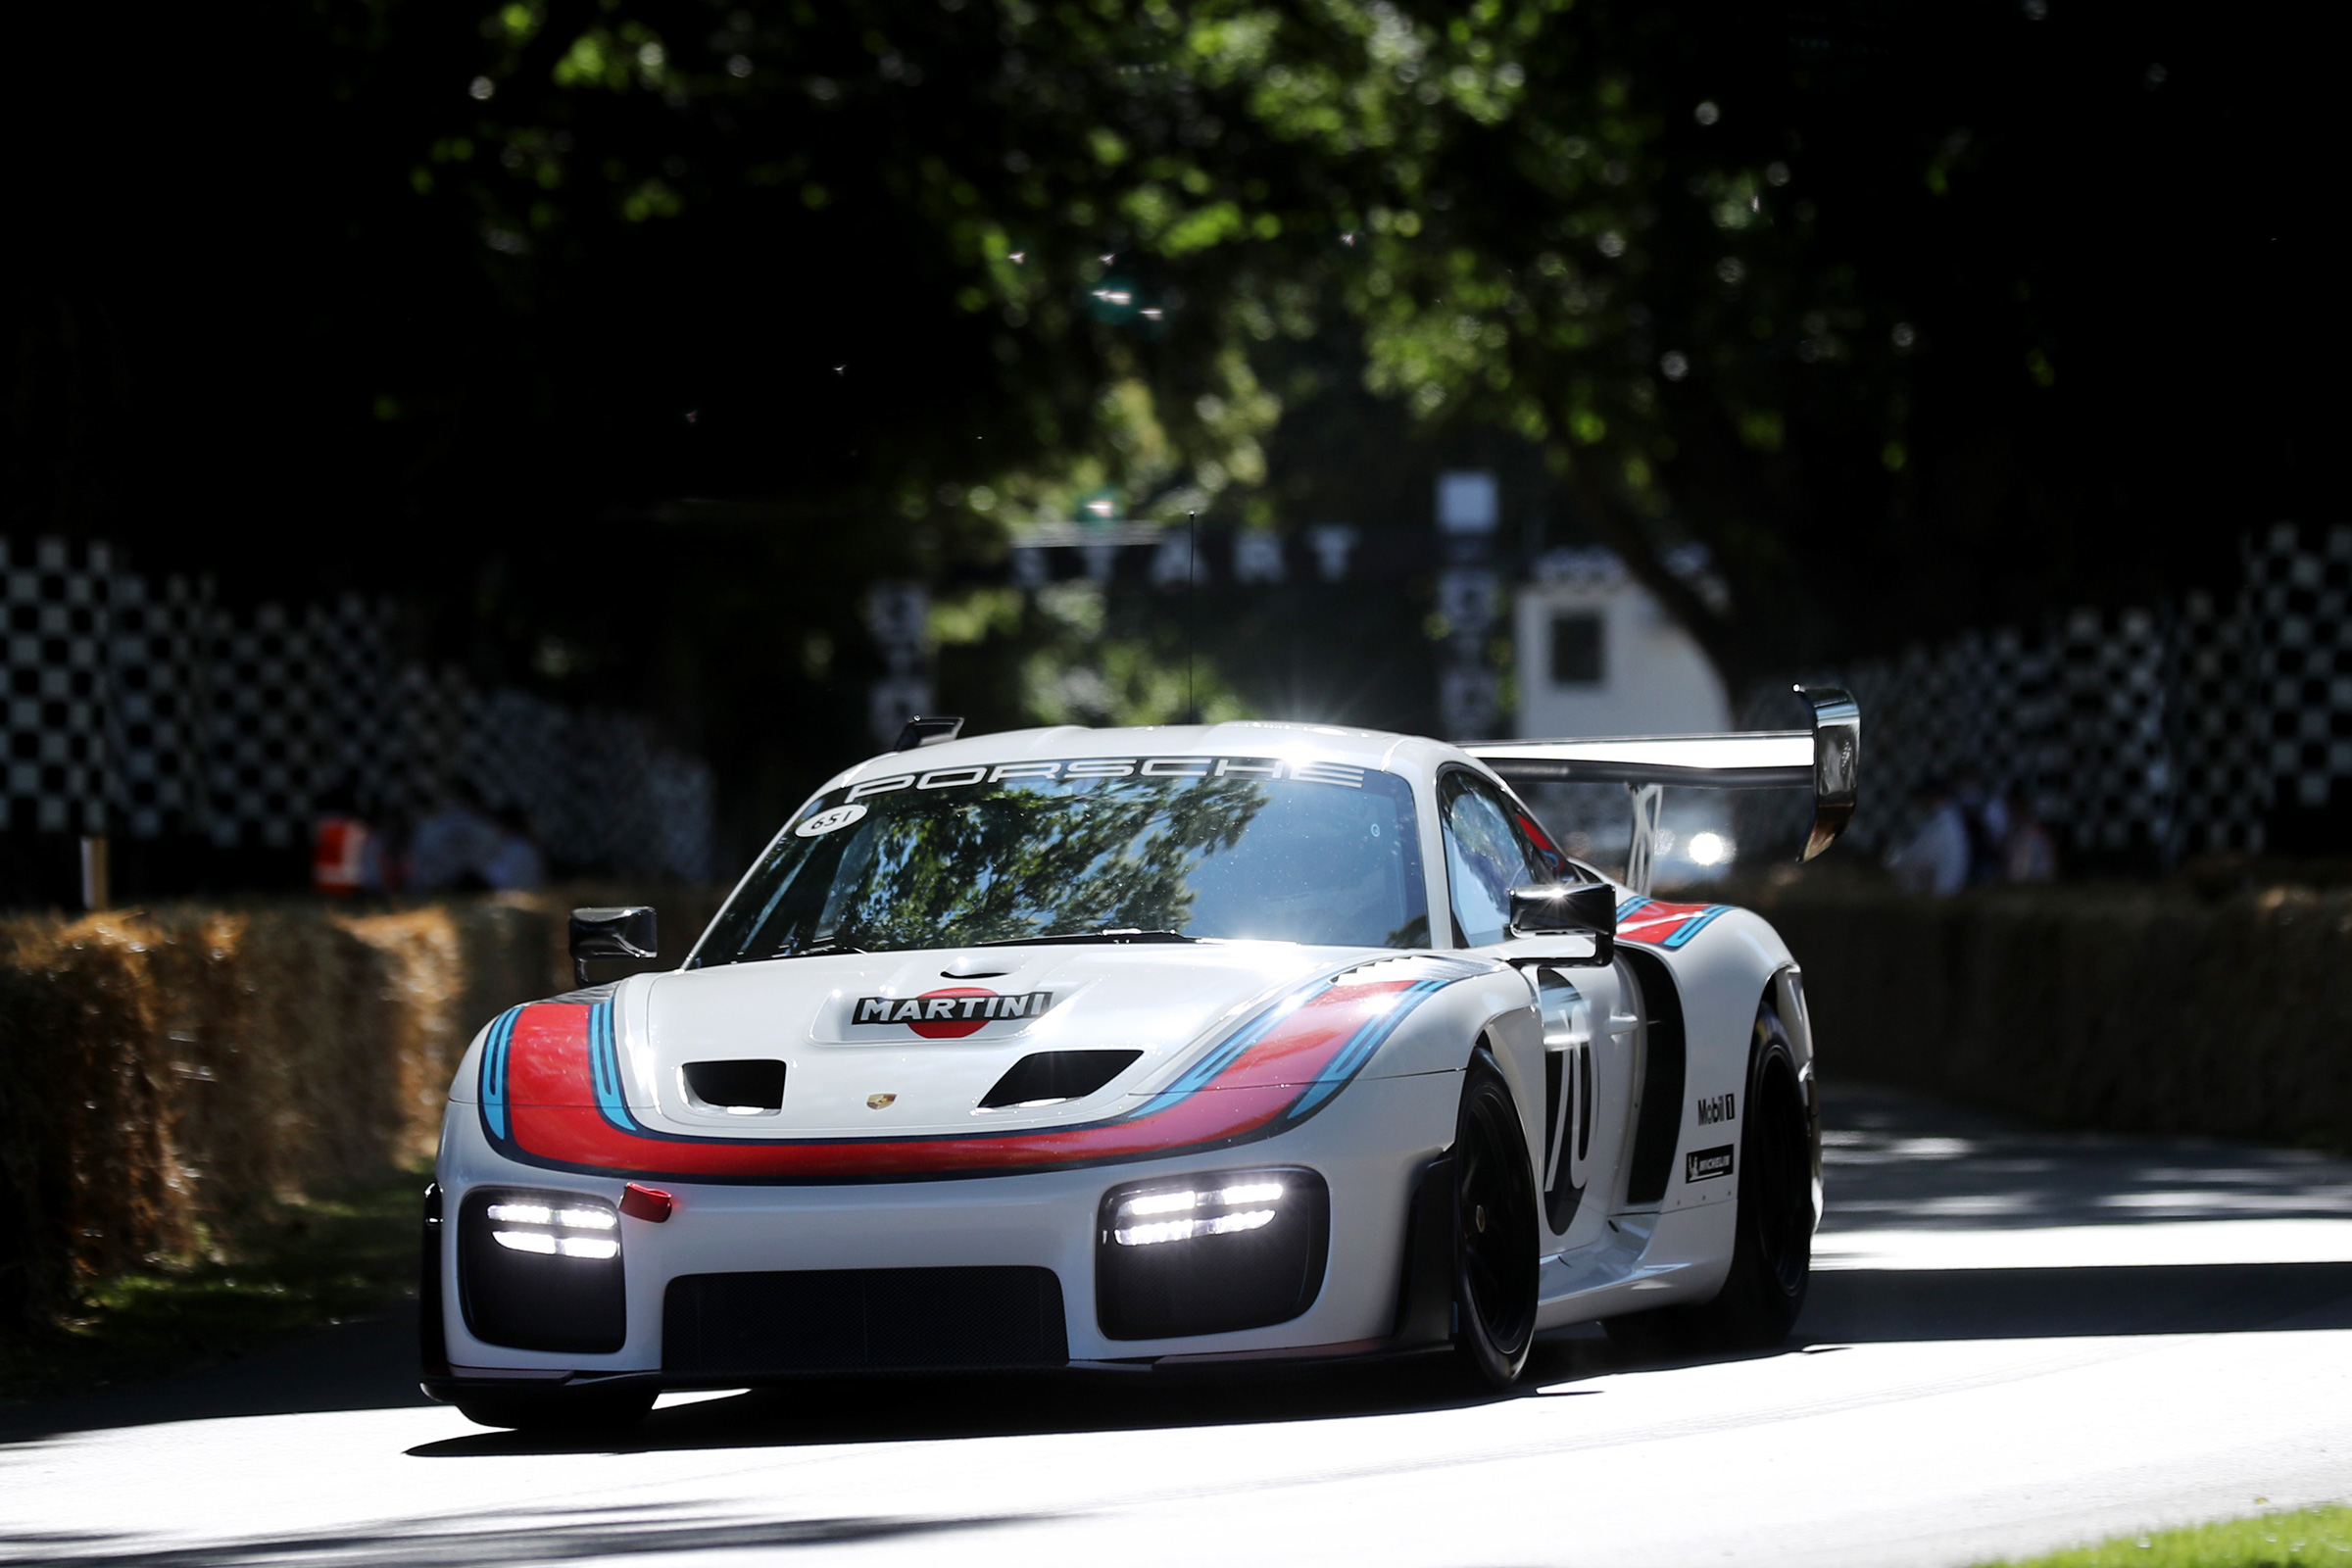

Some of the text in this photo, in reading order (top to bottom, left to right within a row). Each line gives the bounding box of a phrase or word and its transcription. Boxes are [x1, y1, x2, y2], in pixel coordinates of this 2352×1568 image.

[844, 758, 1365, 804] PORSCHE
[810, 809, 854, 830] 651
[859, 993, 1046, 1021] MARTINI
[1697, 1096, 1725, 1126] Mobil
